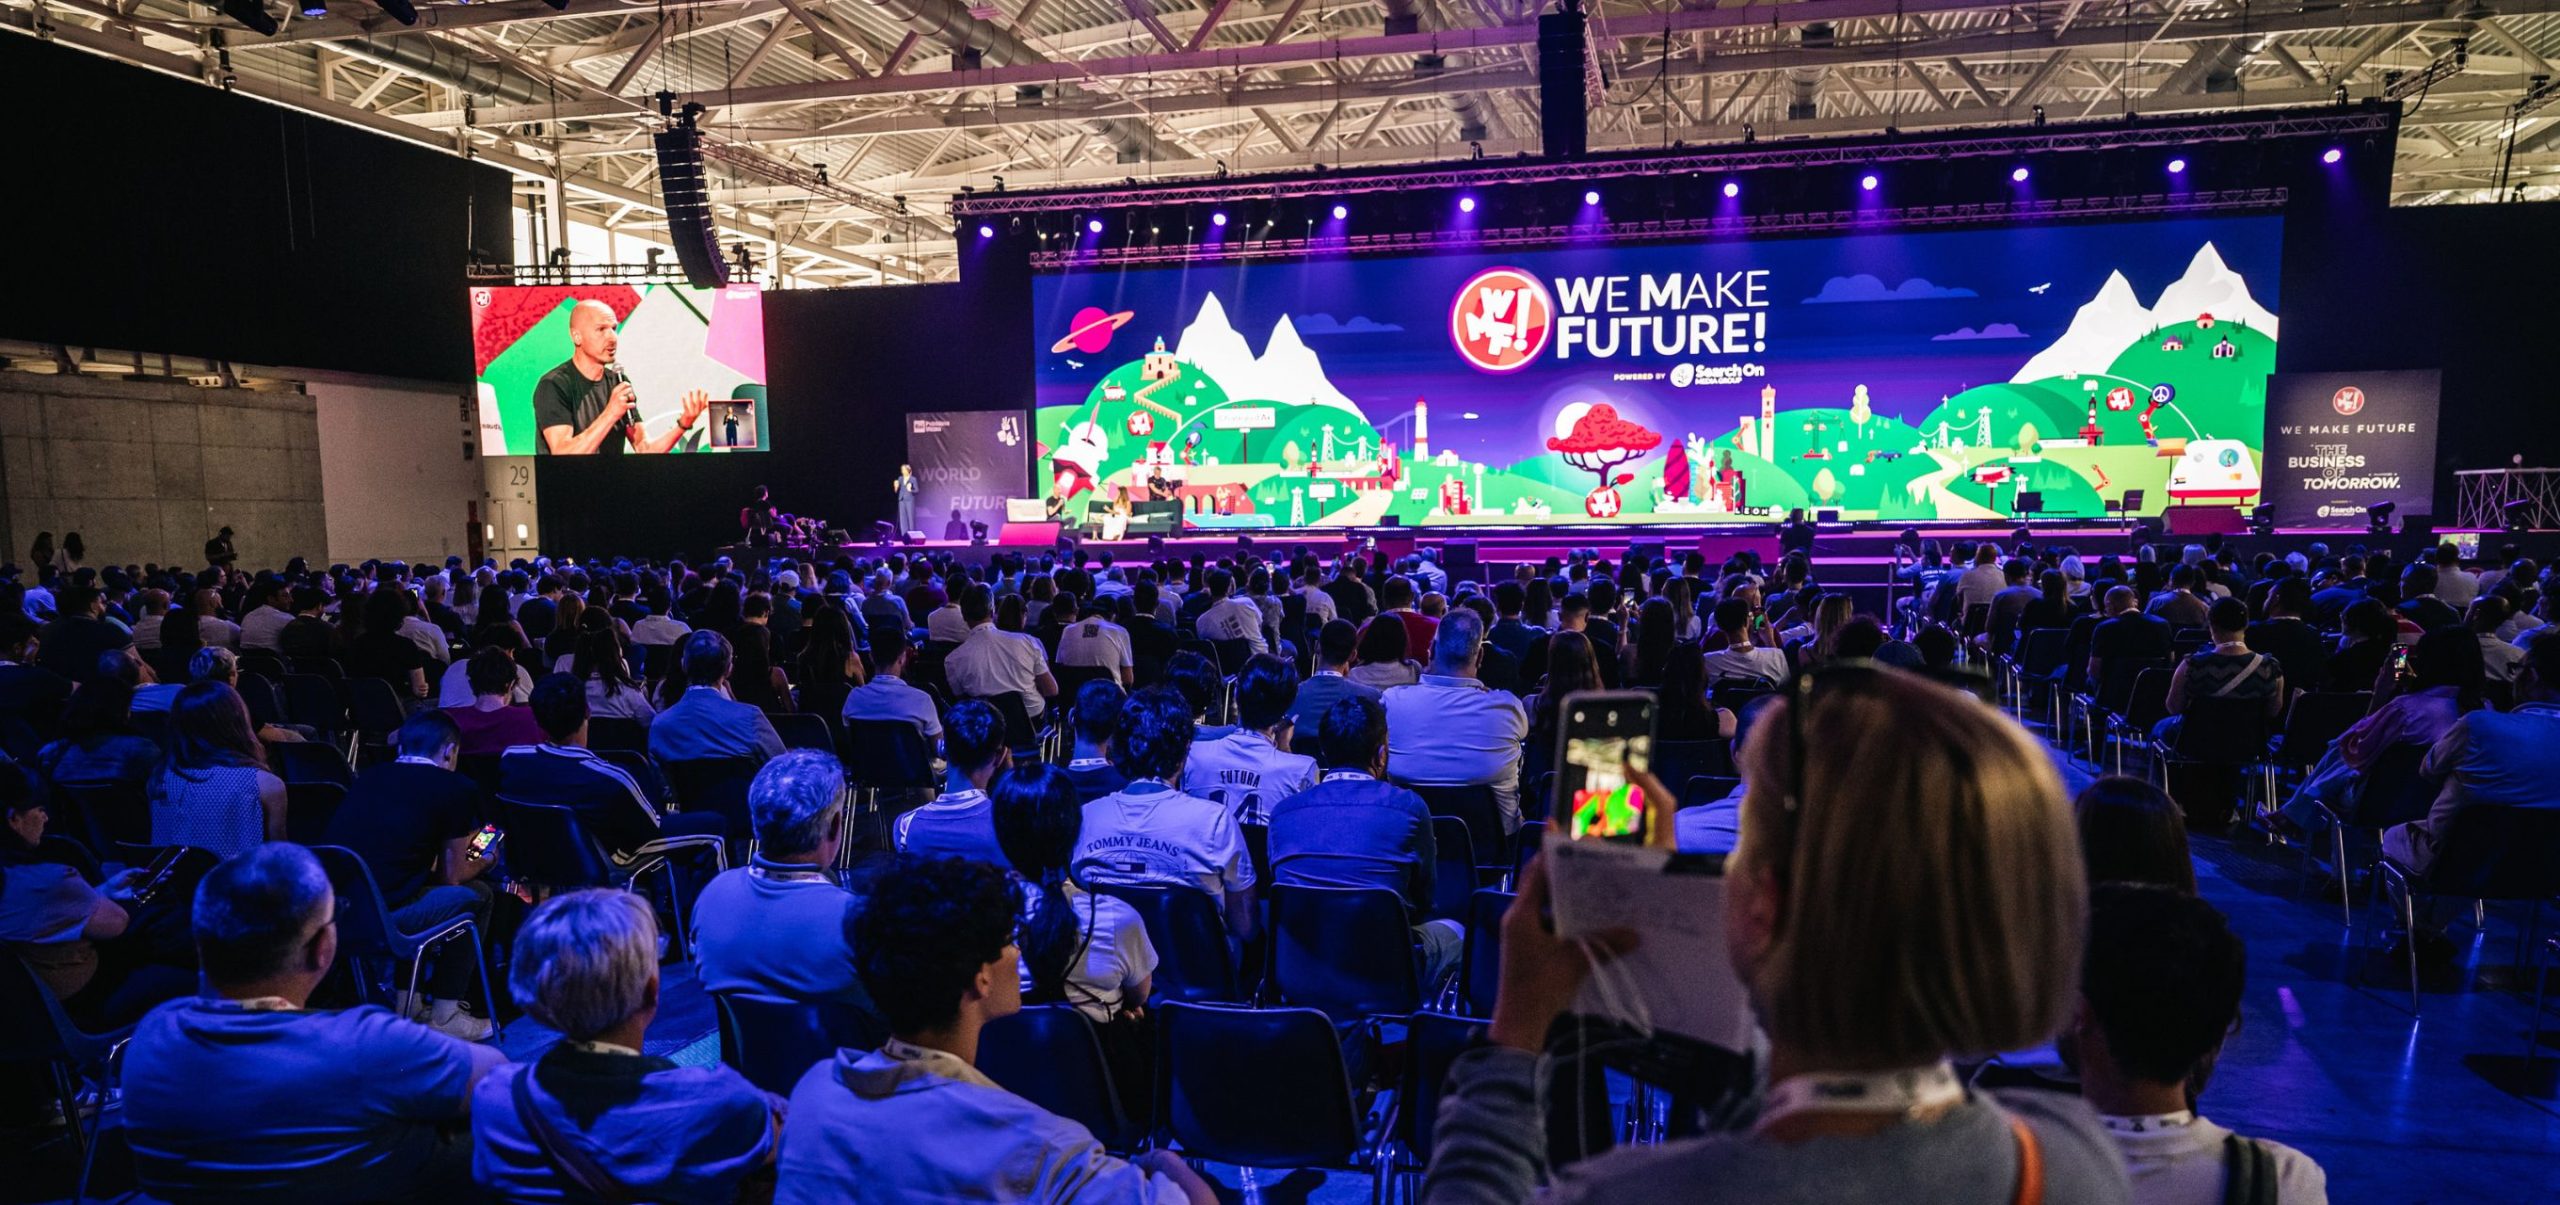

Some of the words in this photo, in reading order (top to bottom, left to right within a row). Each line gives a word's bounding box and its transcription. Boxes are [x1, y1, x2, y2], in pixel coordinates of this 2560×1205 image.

[1555, 276, 1629, 313] WE
[1641, 270, 1769, 311] MAKE
[1557, 313, 1766, 359] FUTURE!
[1613, 372, 1654, 381] POWERED
[1655, 372, 1667, 380] BY
[1695, 363, 1742, 379] Search
[1743, 362, 1765, 377] On
[2281, 425, 2302, 435] WE
[2309, 424, 2350, 434] MAKE
[2357, 423, 2416, 433] FUTURE
[2315, 444, 2347, 456] THE
[2288, 455, 2366, 469] BUSINESS
[510, 465, 529, 486] 29
[919, 467, 981, 481] WORLD
[2322, 467, 2346, 479] OF
[2303, 476, 2401, 490] TOMORROW.
[950, 495, 1016, 511] FUTUR
[1734, 506, 1769, 516] LEON
[2330, 506, 2355, 515] Search
[1220, 770, 1261, 788] FUTURA
[1086, 836, 1134, 853] TOMMY
[1136, 836, 1181, 858] JEANS
